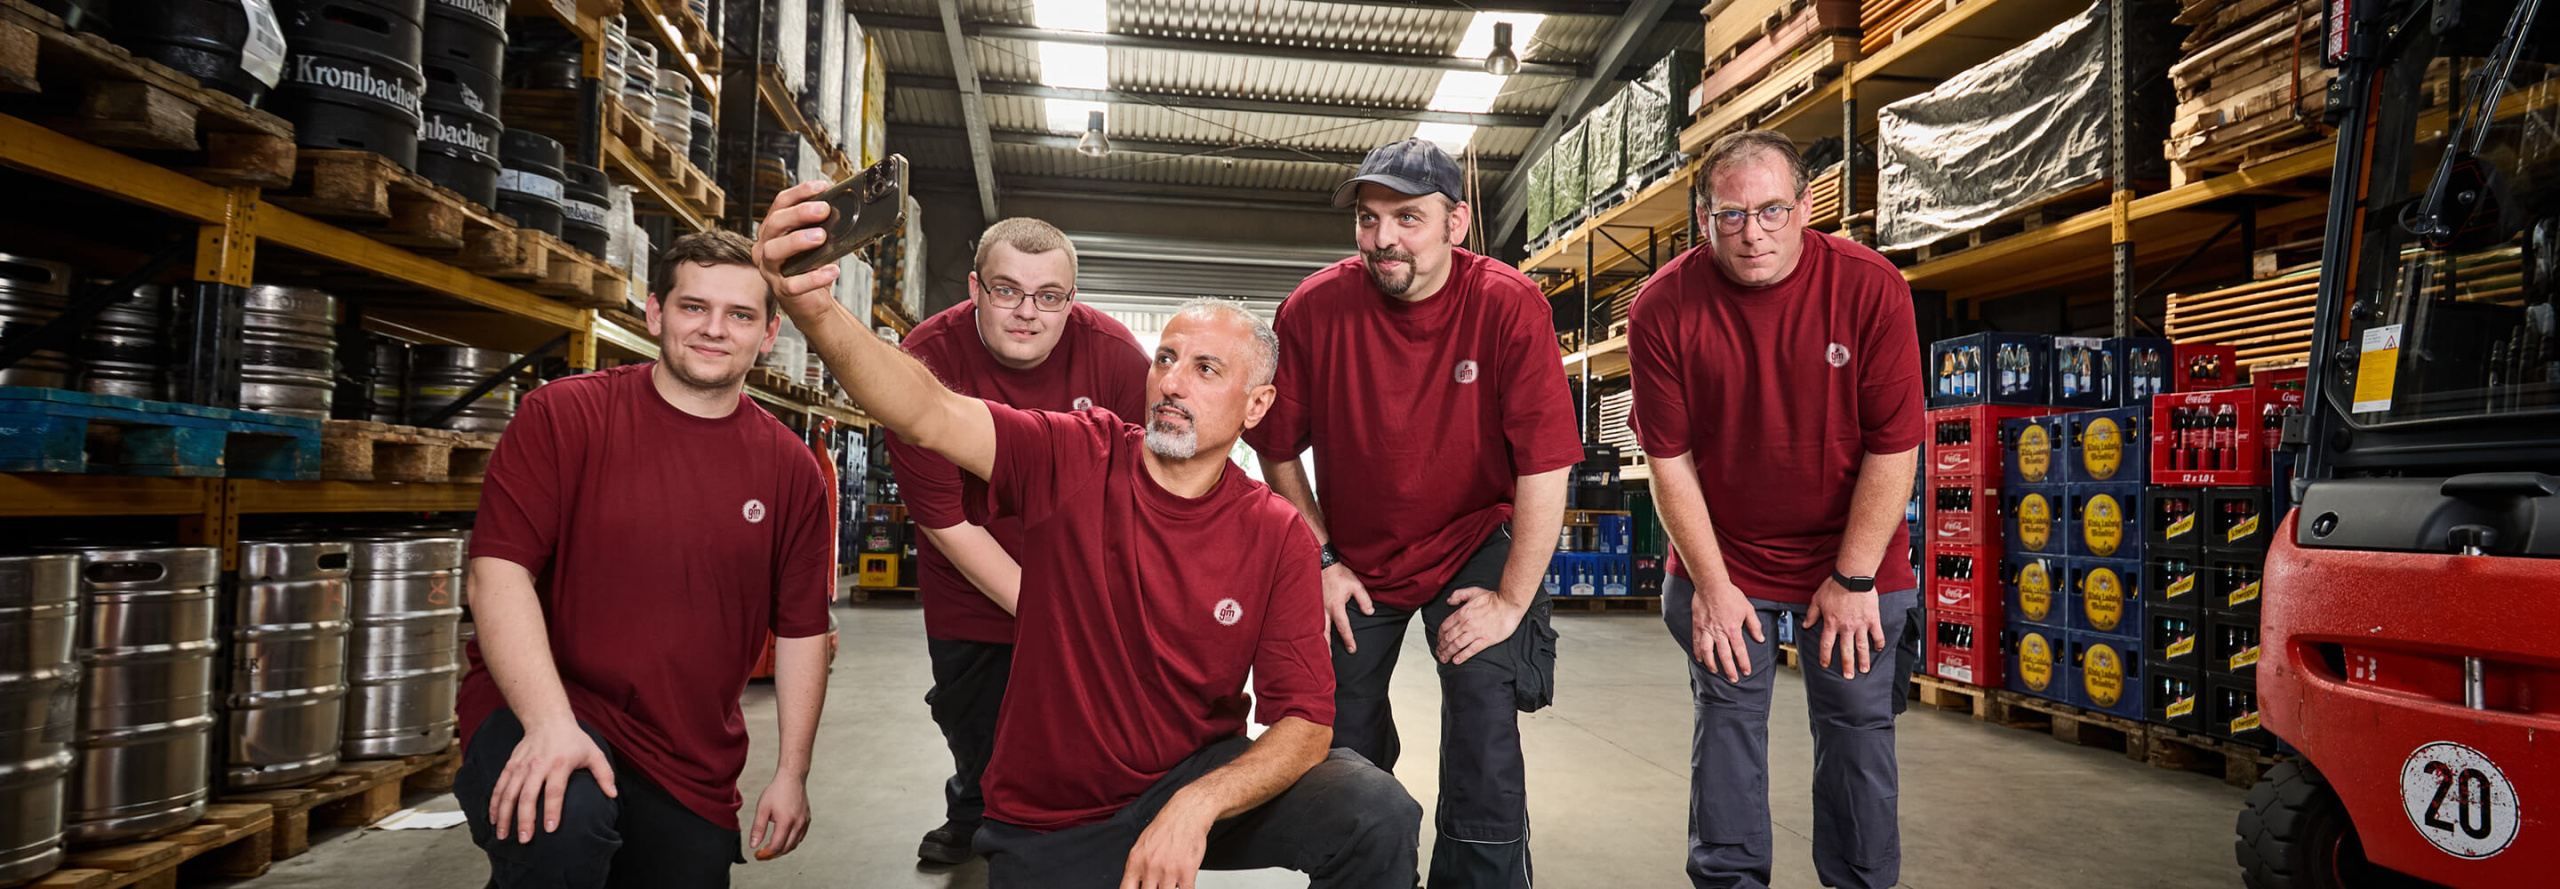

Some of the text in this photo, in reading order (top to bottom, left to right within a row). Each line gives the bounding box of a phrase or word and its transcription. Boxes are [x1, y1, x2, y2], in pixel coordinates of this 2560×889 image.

[296, 54, 416, 112] Krombacher
[2182, 474, 2191, 482] 12
[2198, 474, 2210, 482] 1.0
[2231, 522, 2256, 537] Schweppes
[2232, 587, 2257, 601] Schweppes
[2424, 760, 2491, 840] 20
